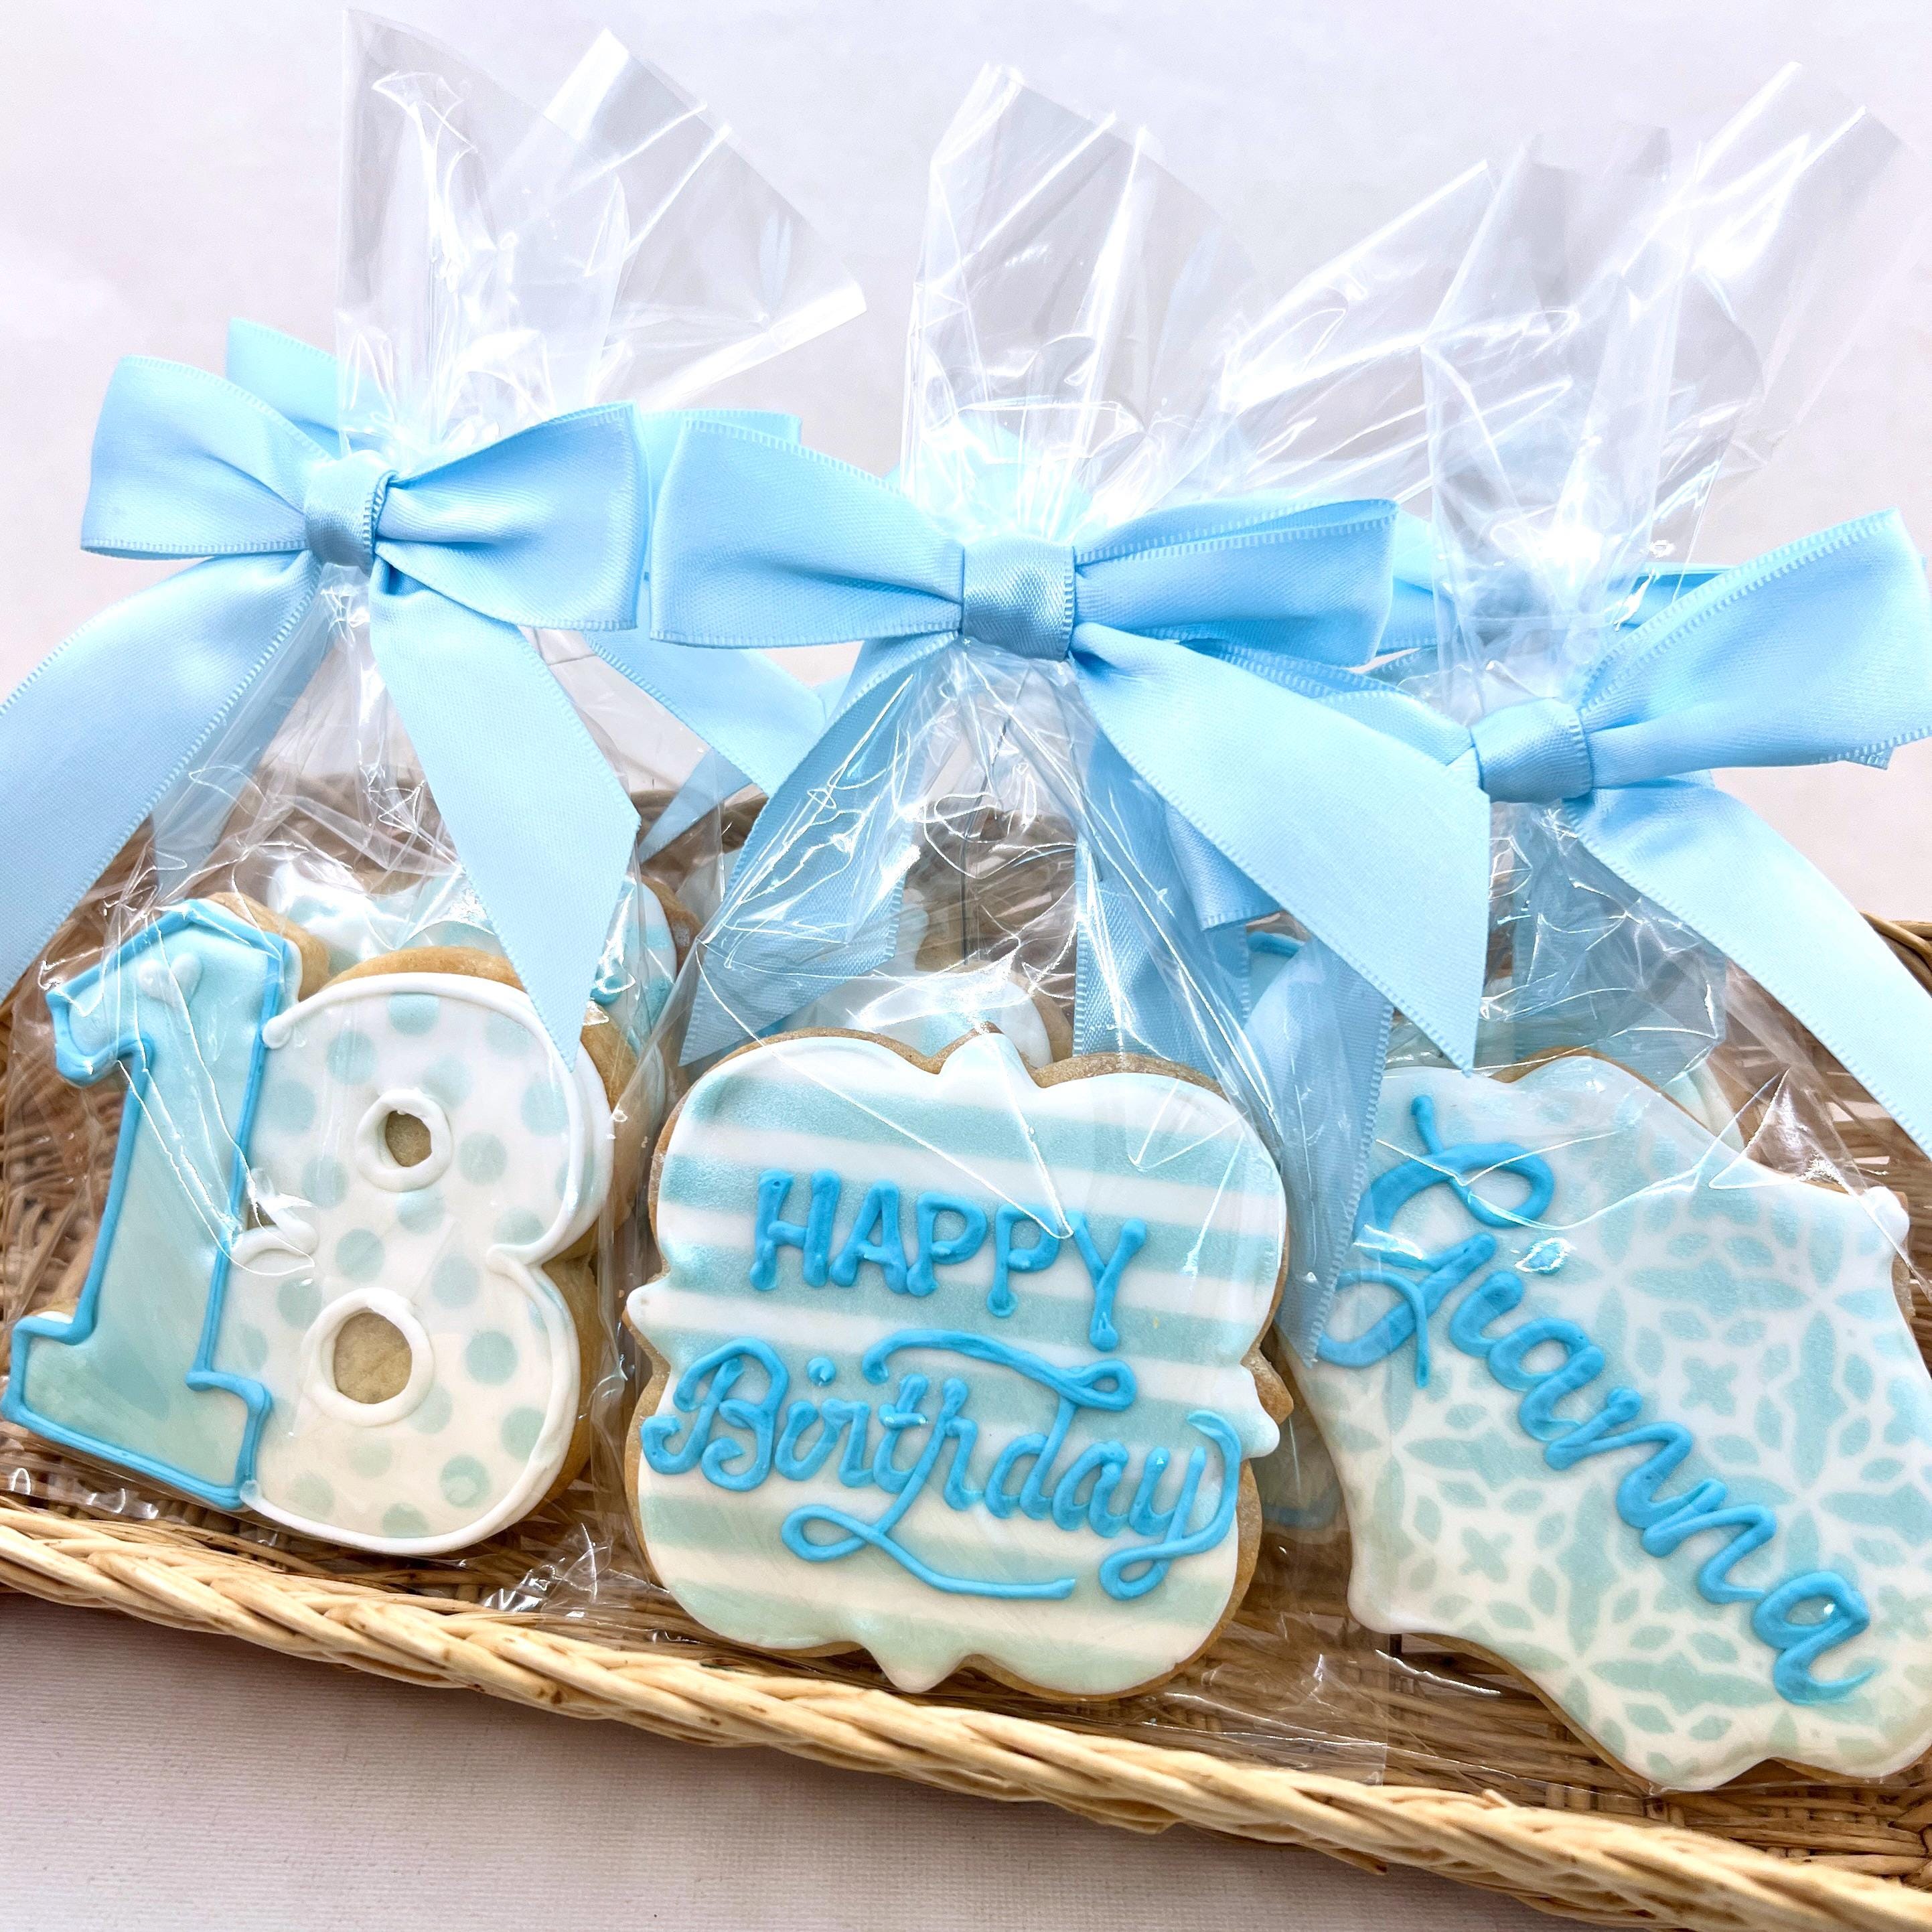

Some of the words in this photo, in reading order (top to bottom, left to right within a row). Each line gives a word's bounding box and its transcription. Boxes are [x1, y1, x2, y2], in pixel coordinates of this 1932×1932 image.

[1, 899, 613, 1554] 18
[751, 1169, 1146, 1350] HAPPY
[1318, 1095, 1876, 1706] Gianna
[641, 1329, 1241, 1601] Birthday
